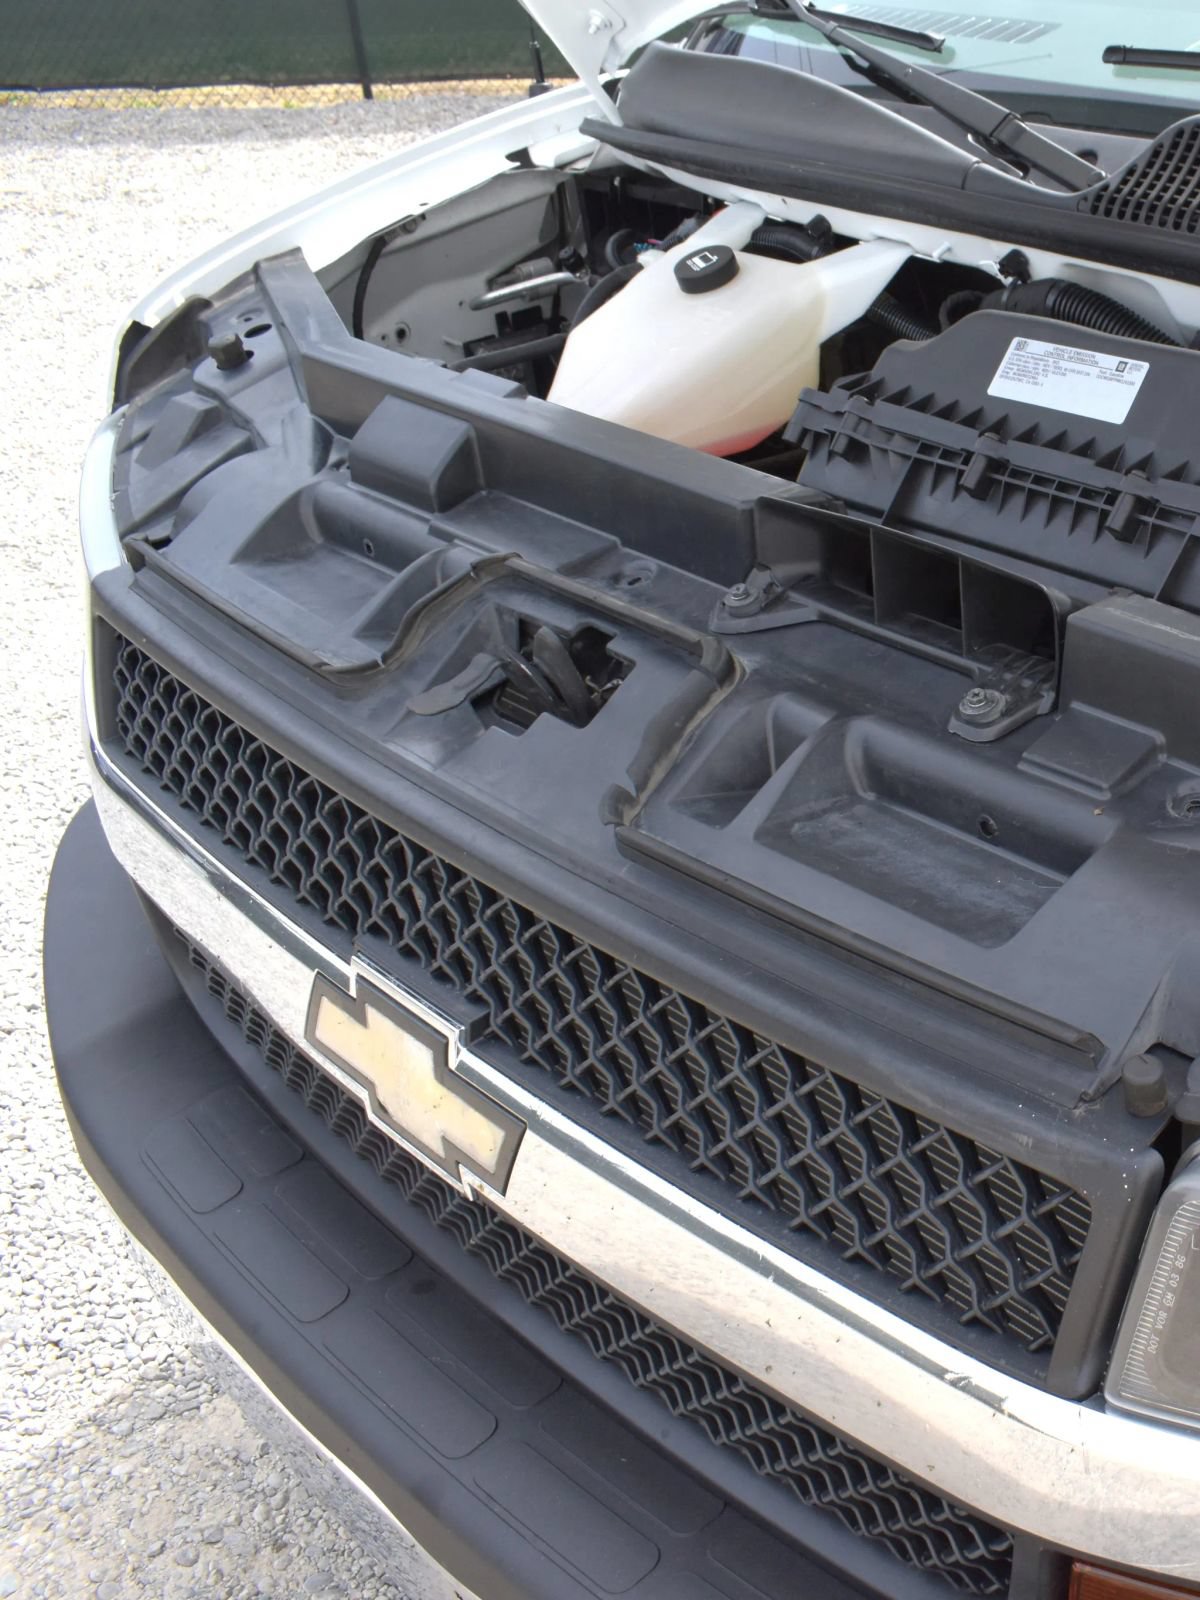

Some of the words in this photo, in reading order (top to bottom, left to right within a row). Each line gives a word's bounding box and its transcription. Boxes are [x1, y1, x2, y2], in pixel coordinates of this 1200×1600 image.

[1169, 1273, 1180, 1288] 03
[1163, 1292, 1176, 1307] GM
[1155, 1311, 1168, 1329] VOR
[1147, 1334, 1160, 1354] DOT
